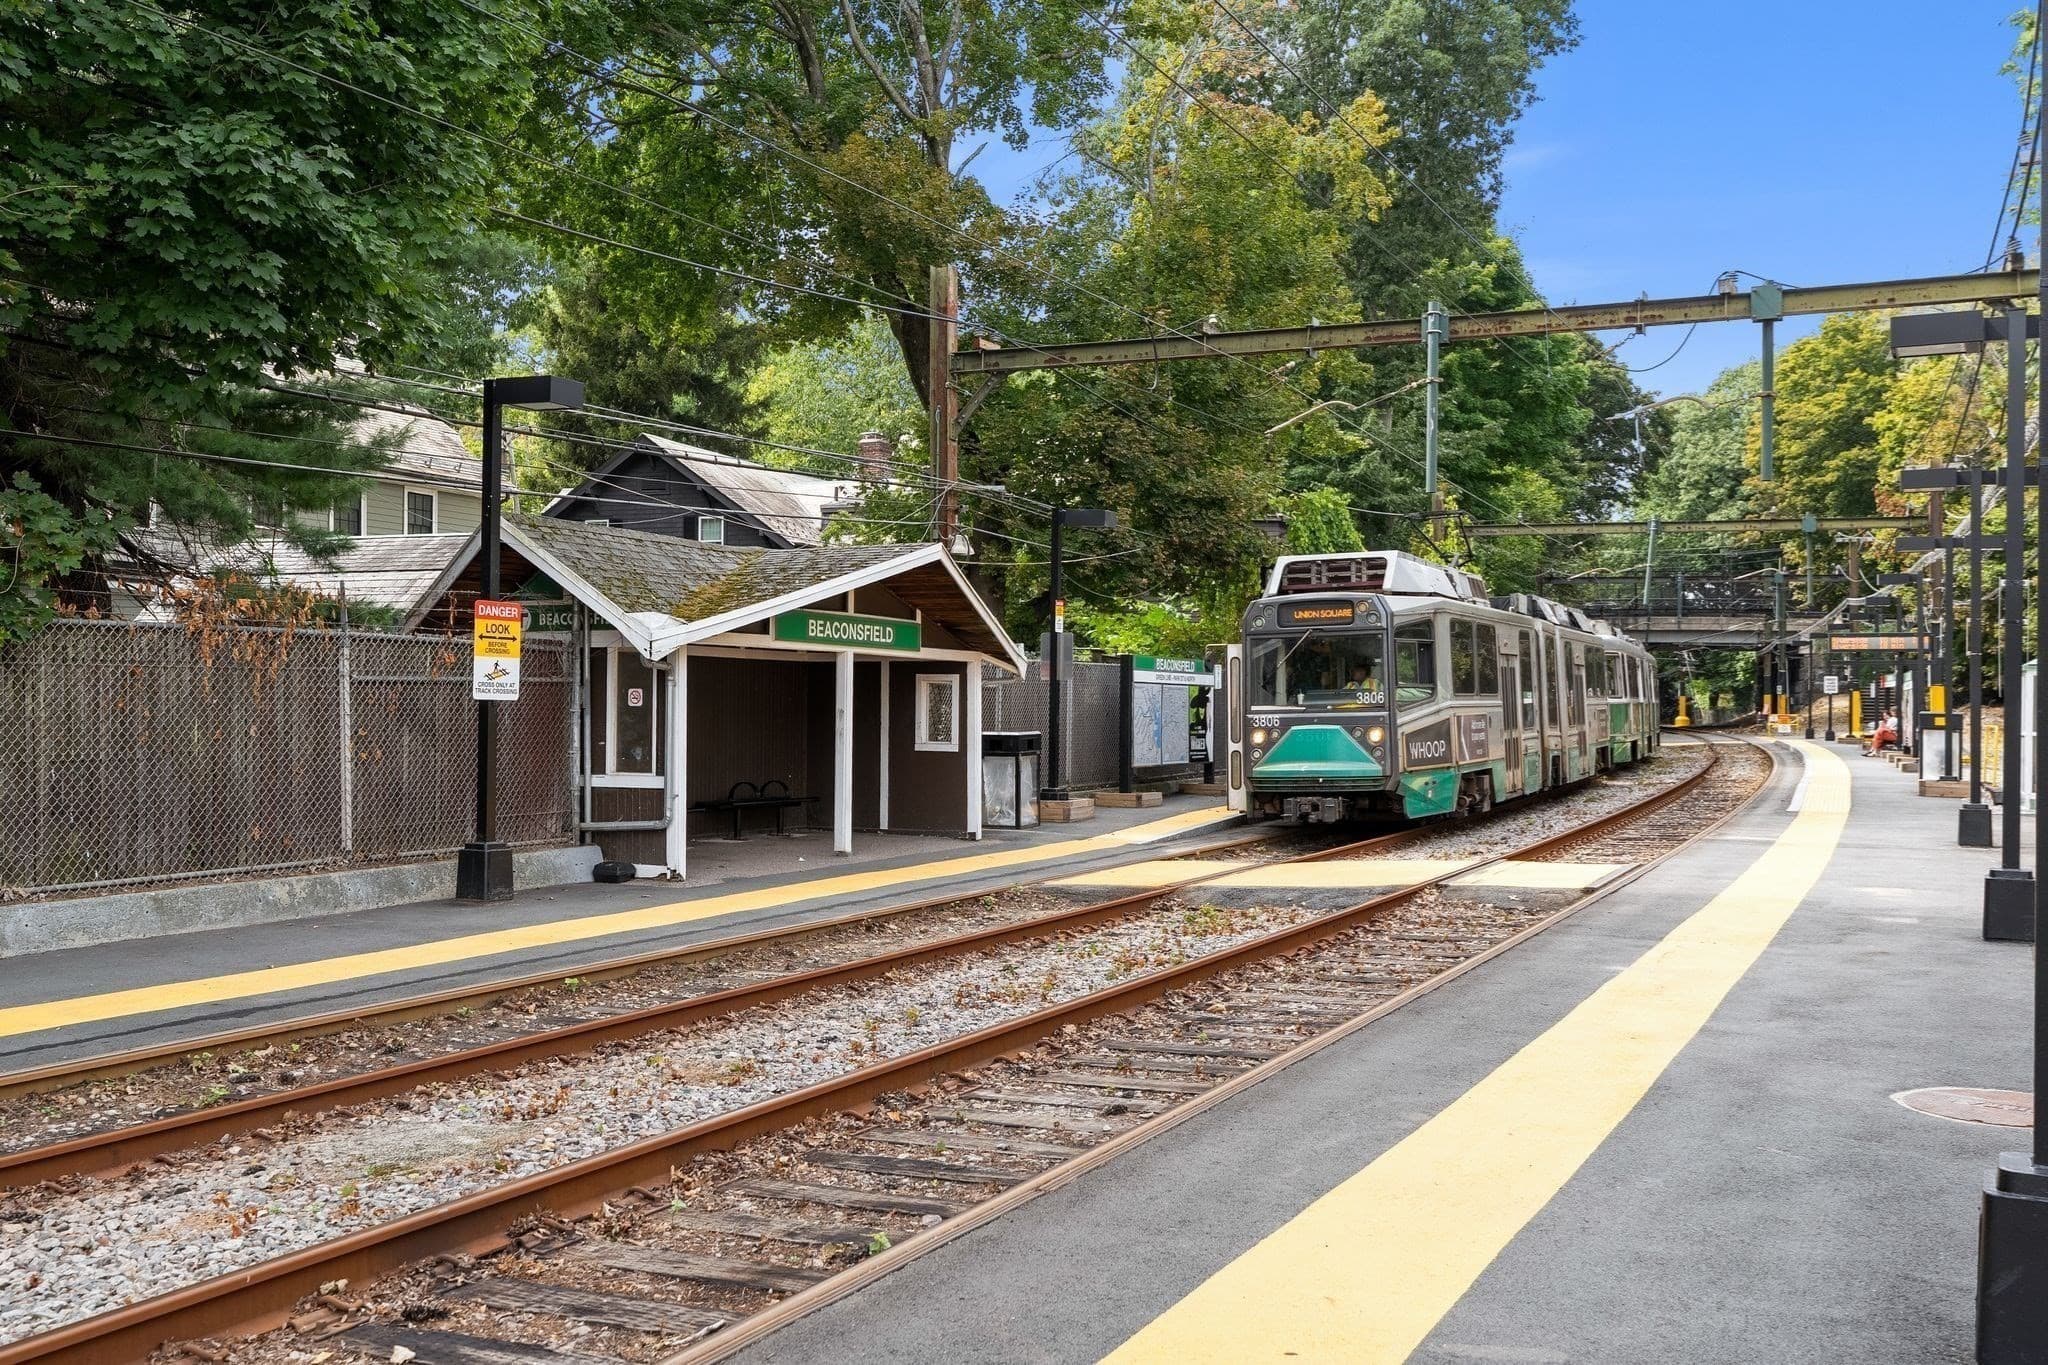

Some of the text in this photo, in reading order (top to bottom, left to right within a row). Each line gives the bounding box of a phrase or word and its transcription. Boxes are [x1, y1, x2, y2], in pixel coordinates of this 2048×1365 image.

[478, 605, 518, 618] DANGER
[1294, 608, 1353, 619] UNION SQUARE
[485, 623, 511, 634] LOOK
[808, 619, 894, 643] BEACONSFIELD
[484, 647, 511, 655] CROSSING
[1156, 658, 1195, 672] BEACONSFIELD
[1356, 692, 1385, 704] 3806
[1252, 715, 1280, 727] 3806
[1409, 741, 1446, 759] WHOOP
